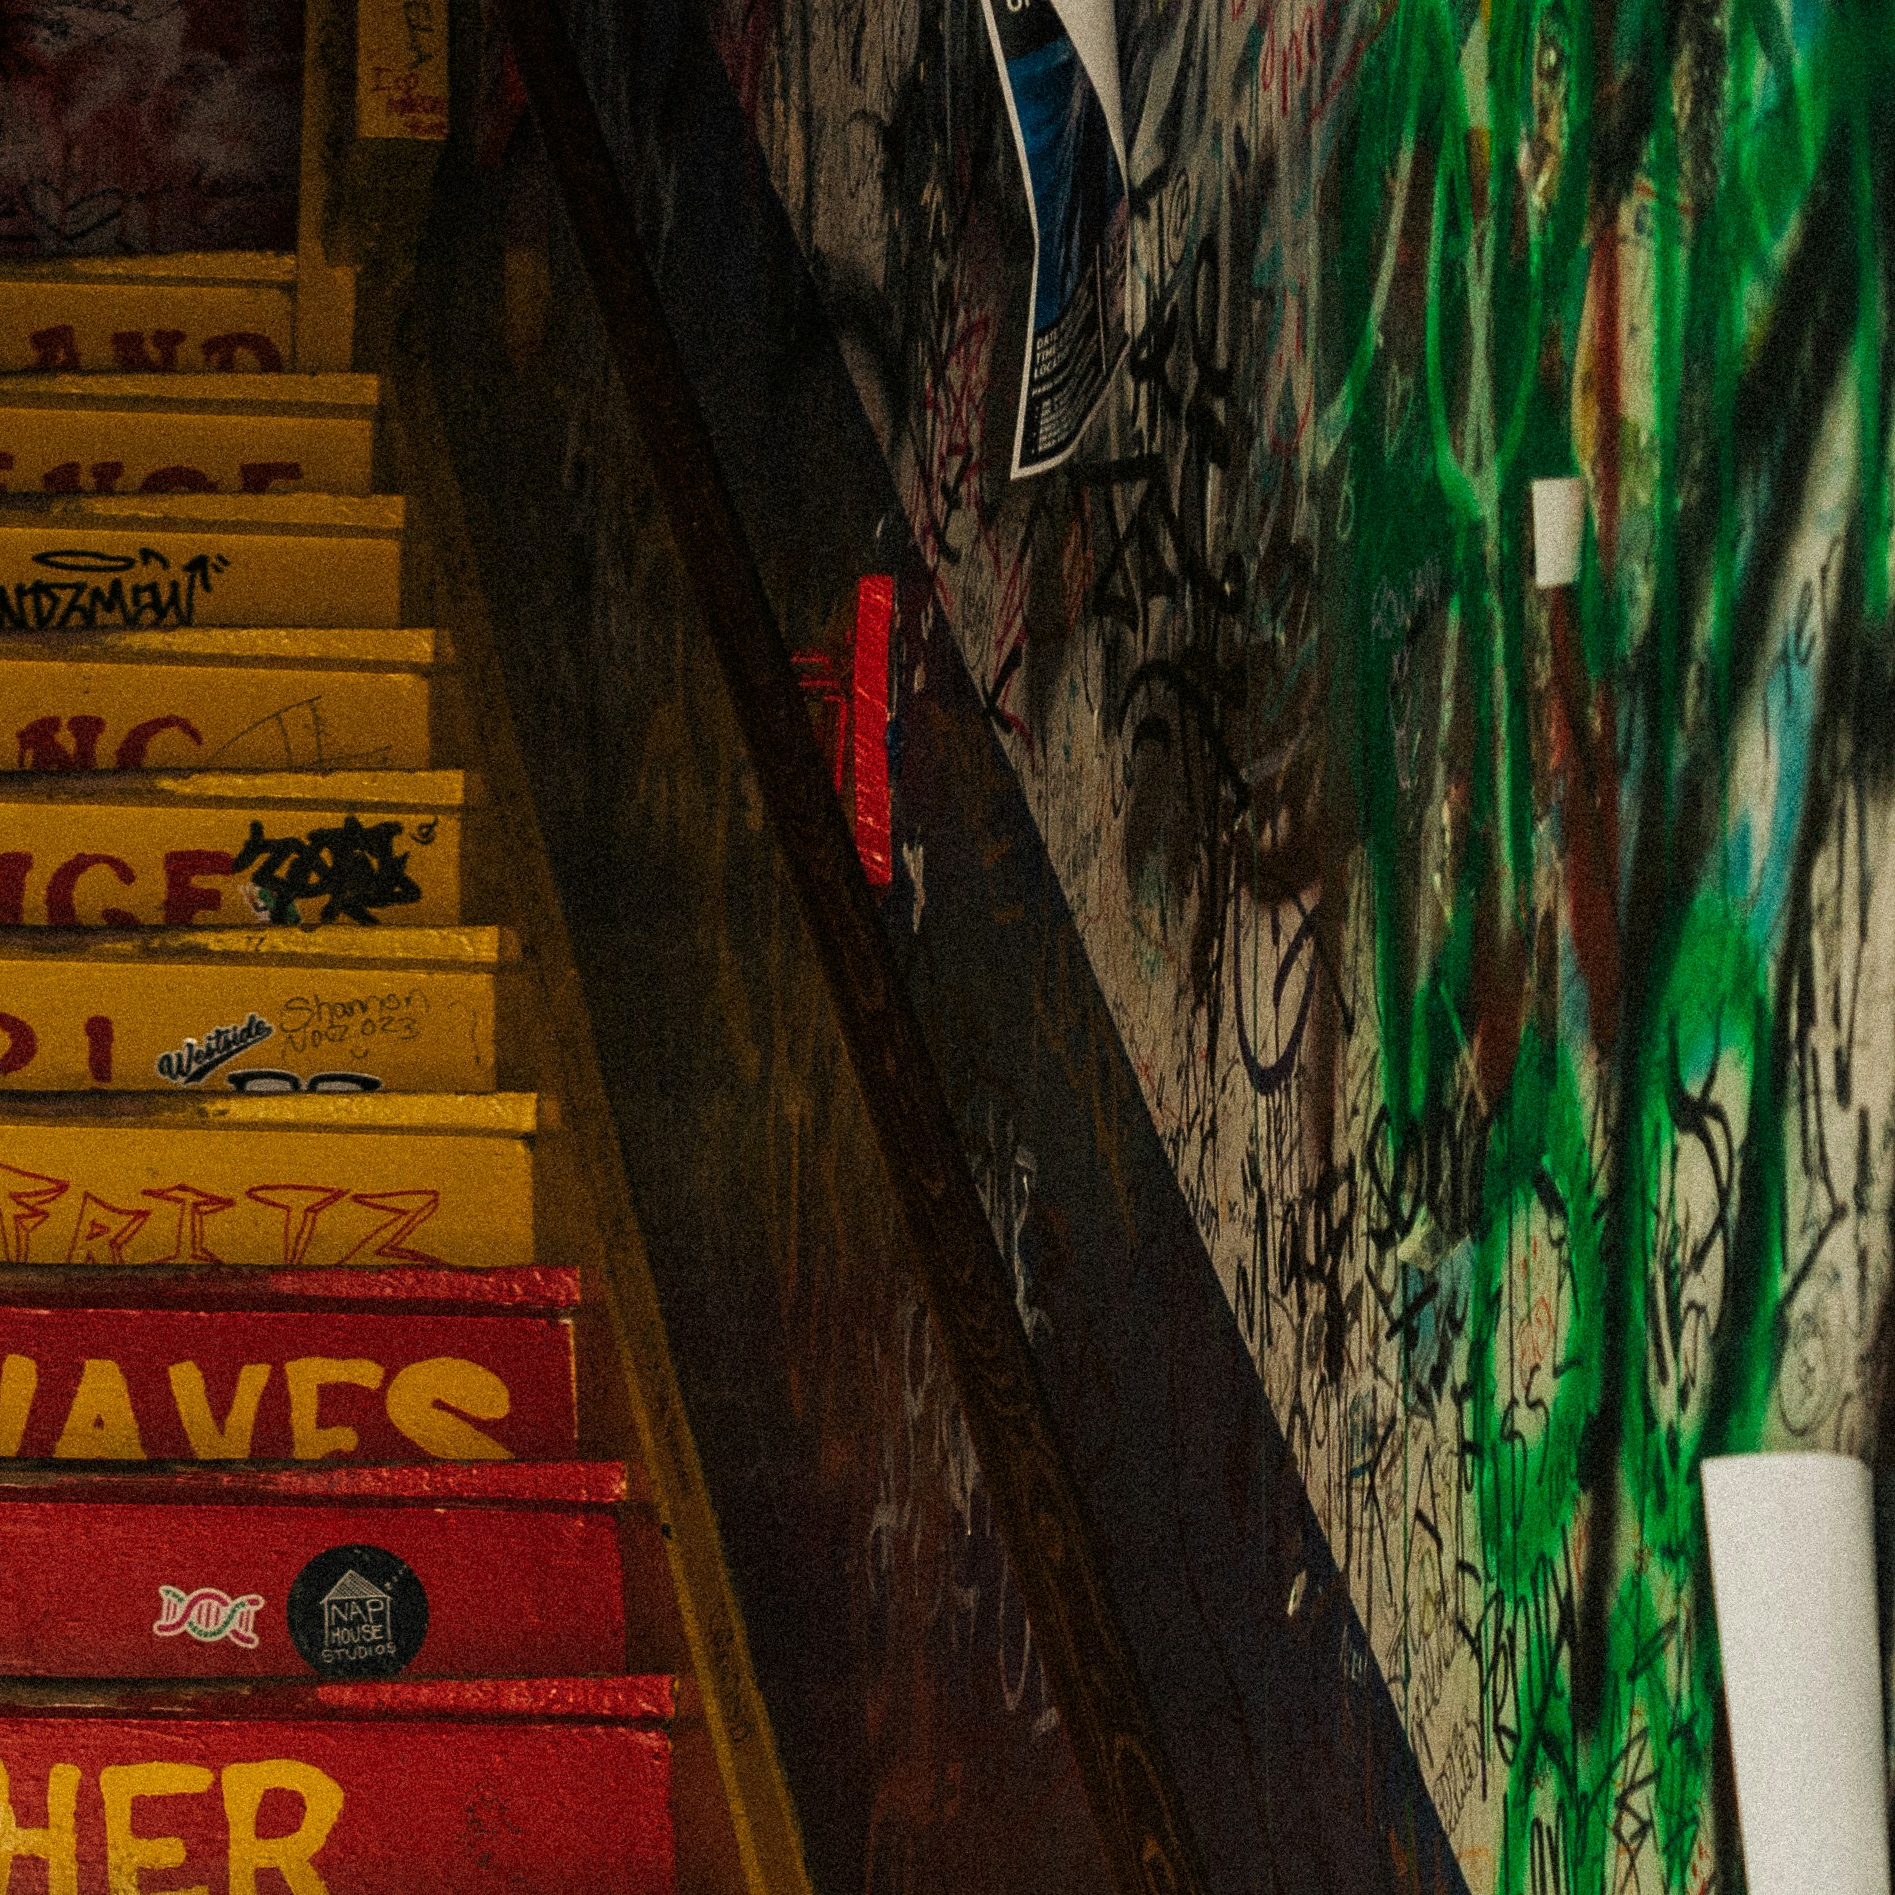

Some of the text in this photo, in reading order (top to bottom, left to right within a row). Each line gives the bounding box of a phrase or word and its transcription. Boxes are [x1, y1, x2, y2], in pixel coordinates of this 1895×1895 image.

[330, 1599, 385, 1626] NAP
[330, 1624, 385, 1645] HOUSE
[321, 1641, 397, 1664] STUDIOS
